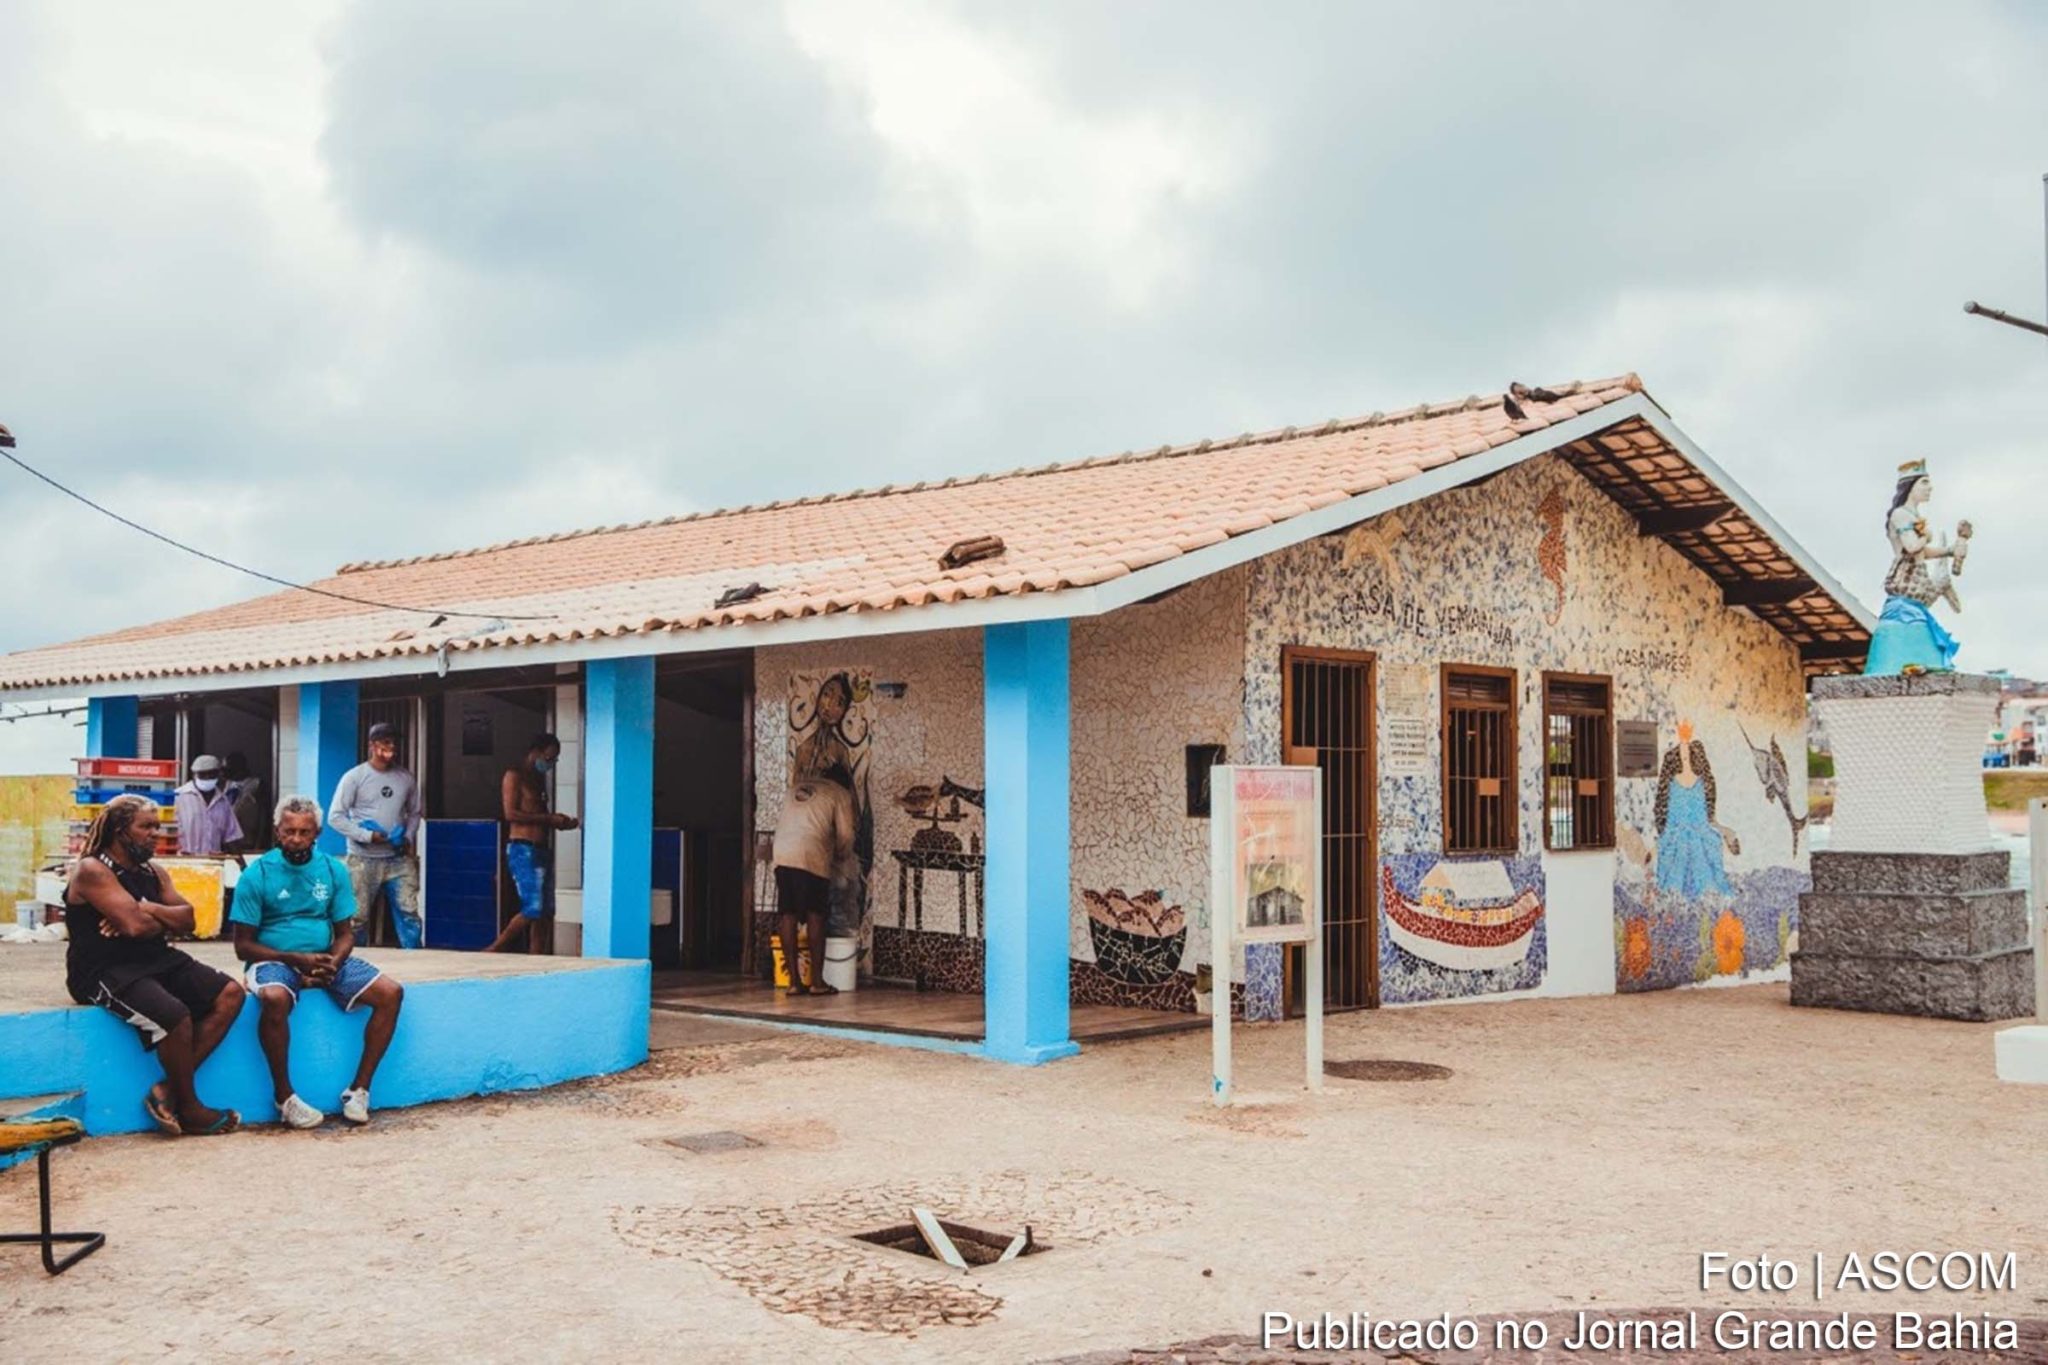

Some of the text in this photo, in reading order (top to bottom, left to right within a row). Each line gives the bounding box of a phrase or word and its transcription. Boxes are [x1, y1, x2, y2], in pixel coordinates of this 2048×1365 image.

[1340, 584, 1396, 624] CASA
[1402, 601, 1426, 638] DE
[1616, 647, 1648, 669] CASA
